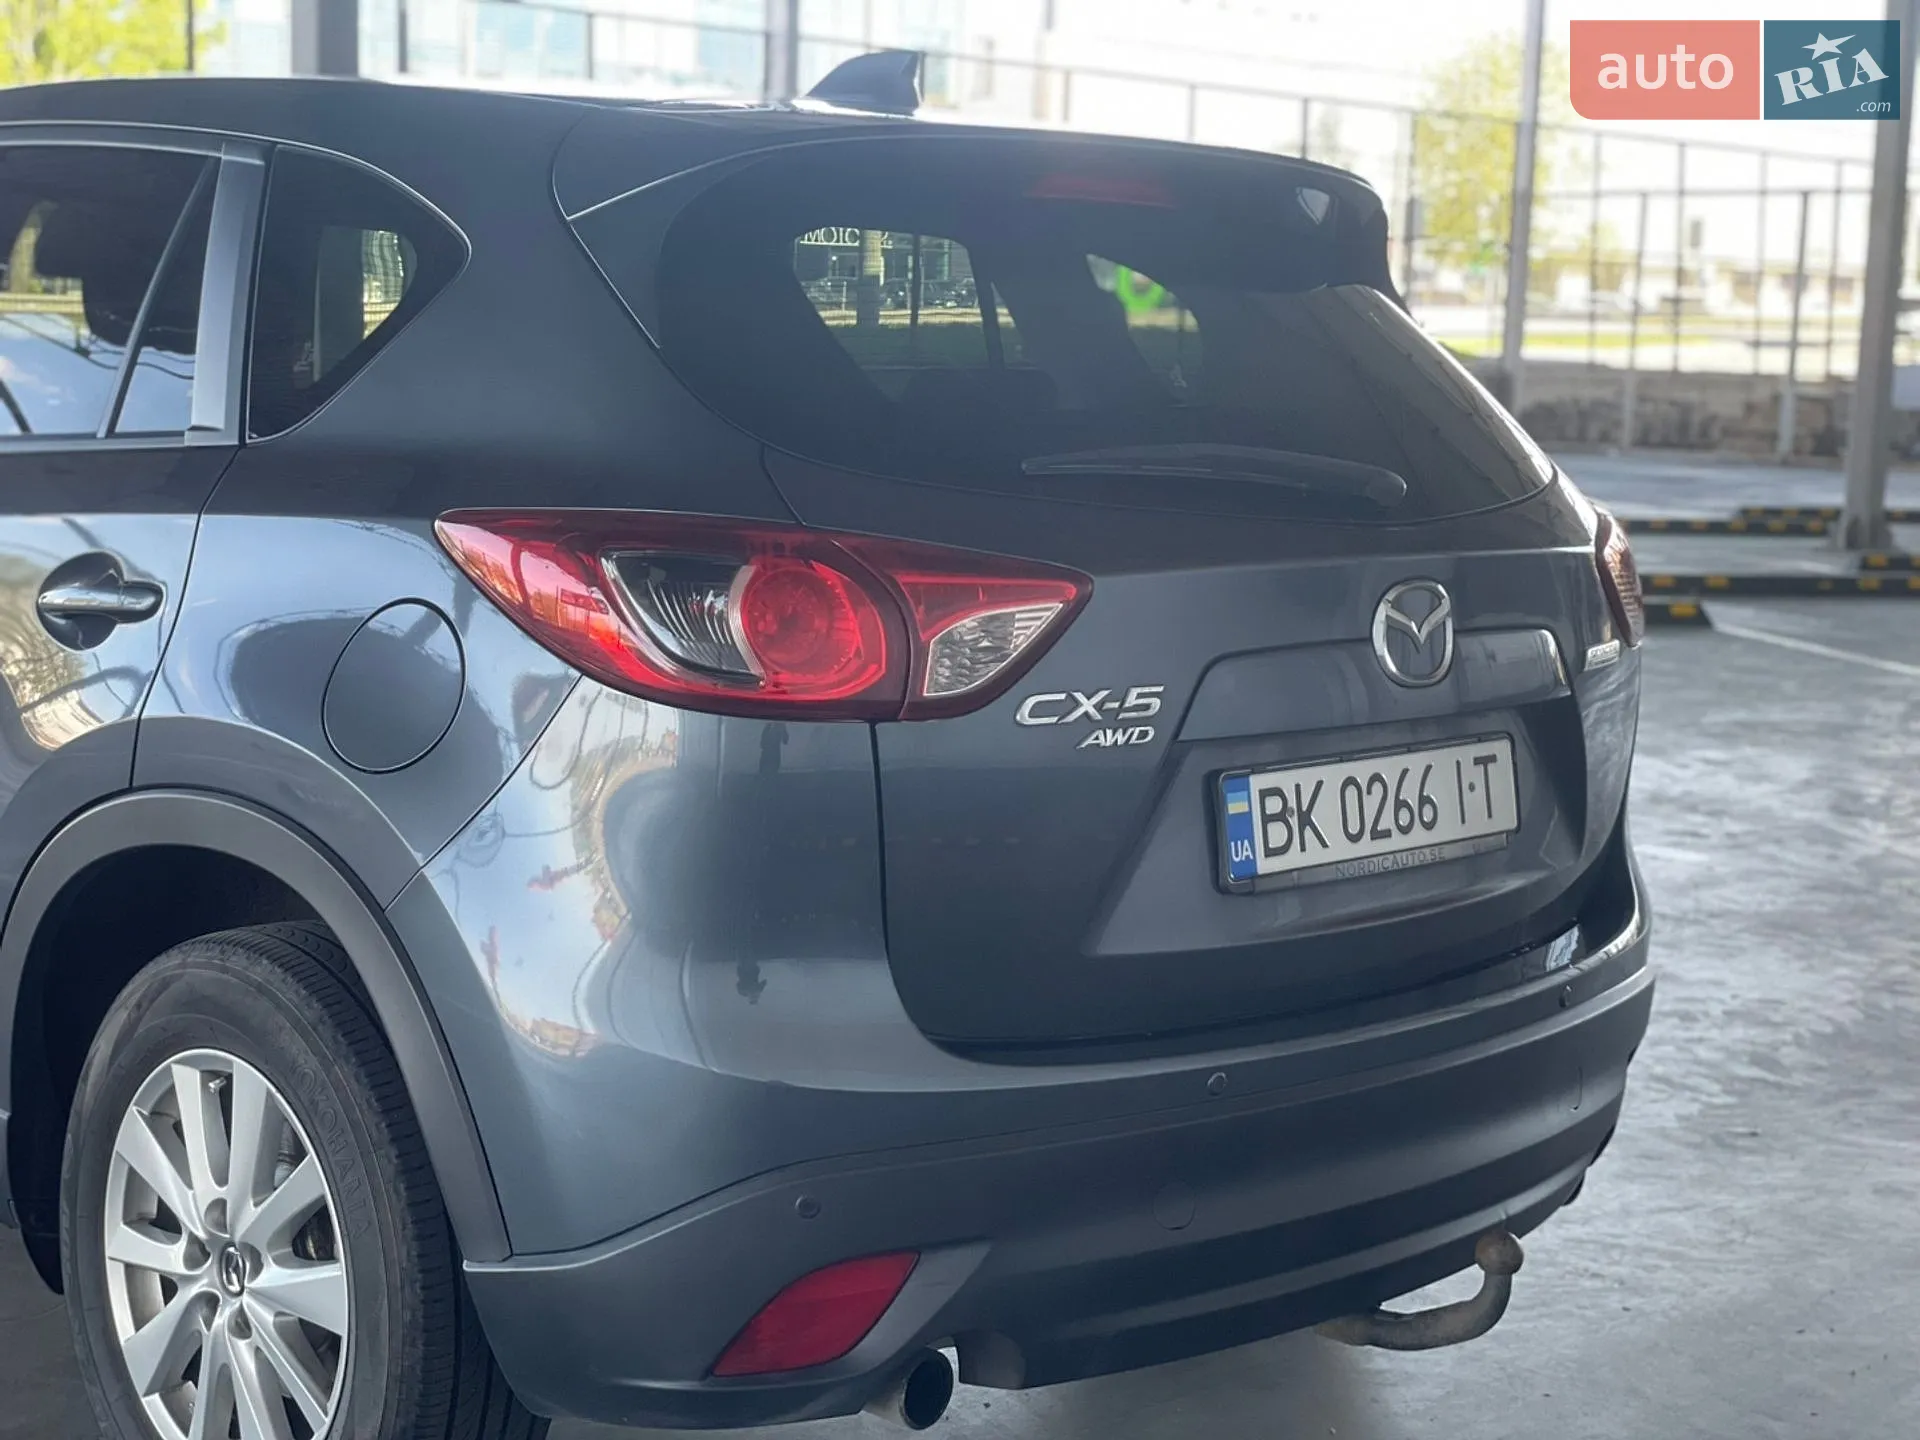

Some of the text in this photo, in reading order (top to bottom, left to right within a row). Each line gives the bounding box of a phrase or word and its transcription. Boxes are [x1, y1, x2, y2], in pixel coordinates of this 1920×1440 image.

[1015, 685, 1165, 726] CX-5
[1075, 726, 1155, 750] AWD
[1258, 753, 1498, 858] BK 0266 IT
[1230, 839, 1253, 863] UA
